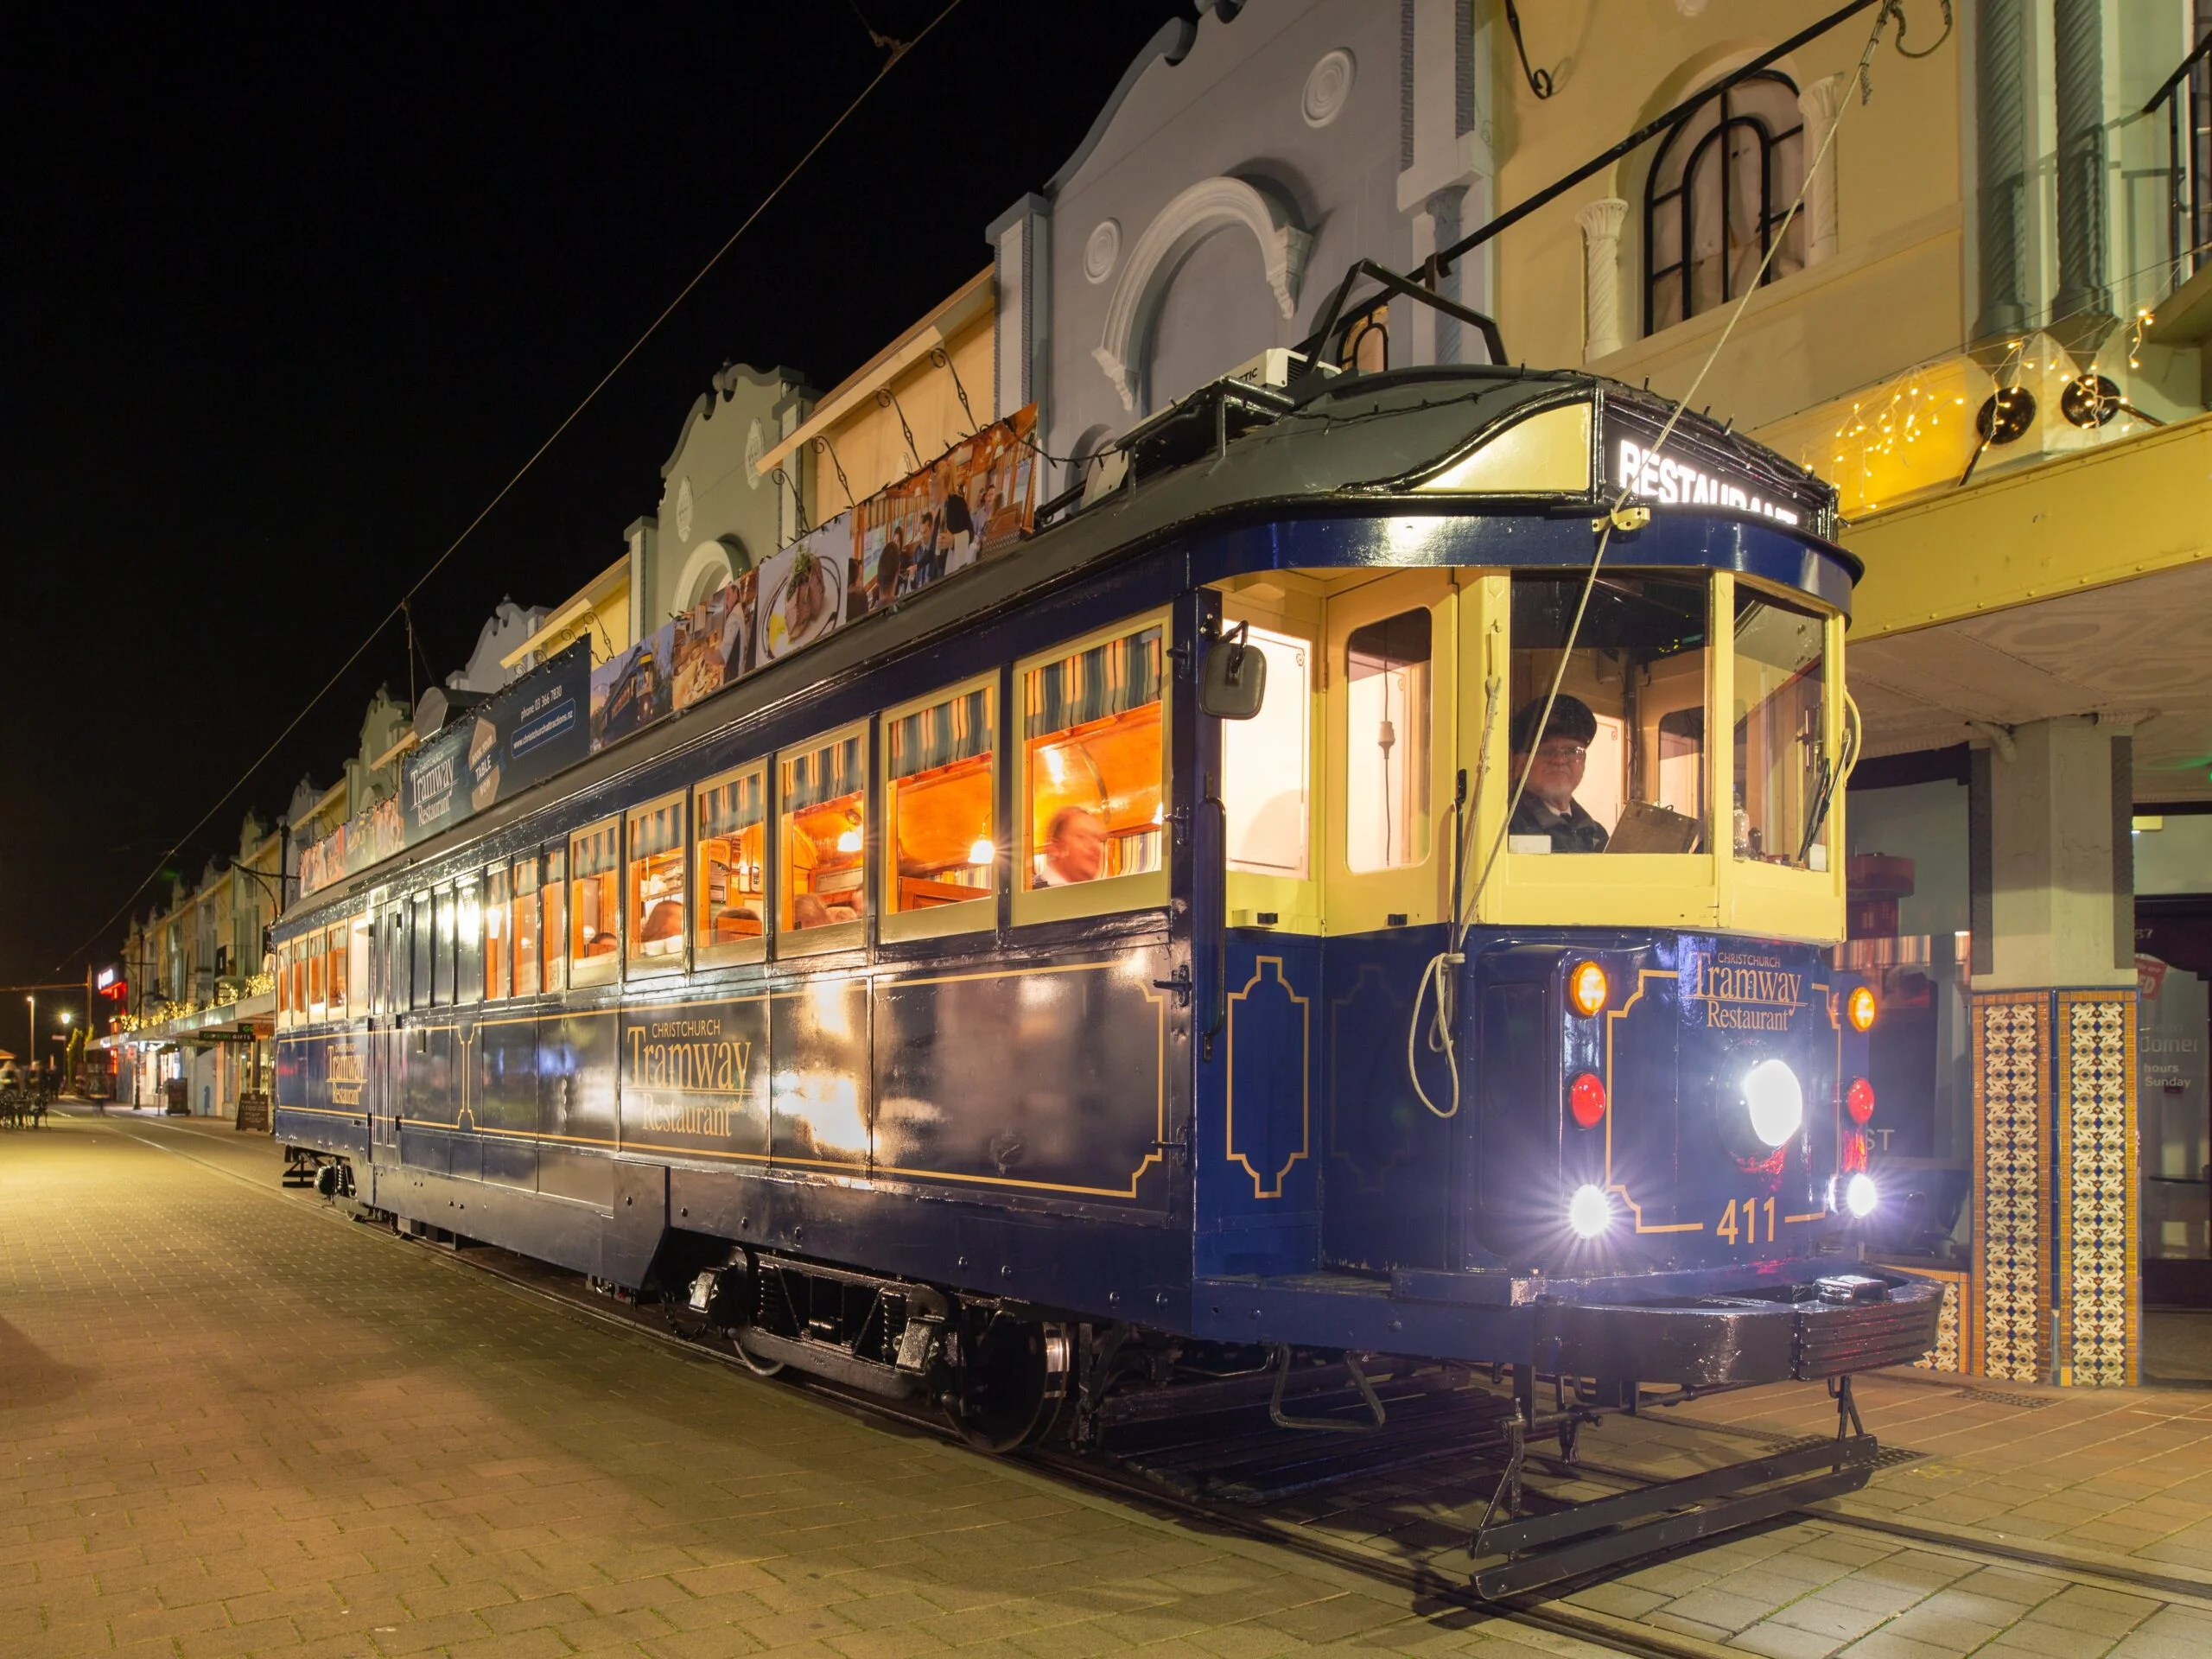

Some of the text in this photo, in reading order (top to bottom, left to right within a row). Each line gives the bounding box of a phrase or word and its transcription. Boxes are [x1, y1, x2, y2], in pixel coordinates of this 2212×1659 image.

[1619, 439, 1798, 524] RESTAUR
[520, 684, 563, 722] phone 03 366 7830
[410, 756, 454, 806] Tramway
[475, 754, 492, 782] TABLE
[480, 777, 492, 797] NOW
[418, 796, 450, 827] Restaurant
[1718, 952, 1781, 968] CHRISTCHURCH
[1689, 951, 1802, 1017] Tramway
[652, 1019, 721, 1038] CHRISTCHURCH
[1707, 1000, 1788, 1031] Restaurant
[327, 1046, 365, 1093] Tramway
[627, 1026, 751, 1112] Tramway
[2144, 1063, 2179, 1072] hours
[2145, 1076, 2191, 1089] Sunday
[332, 1081, 359, 1105] Restaurant
[643, 1093, 732, 1137] Restaurant
[1716, 1196, 1775, 1245] 411
